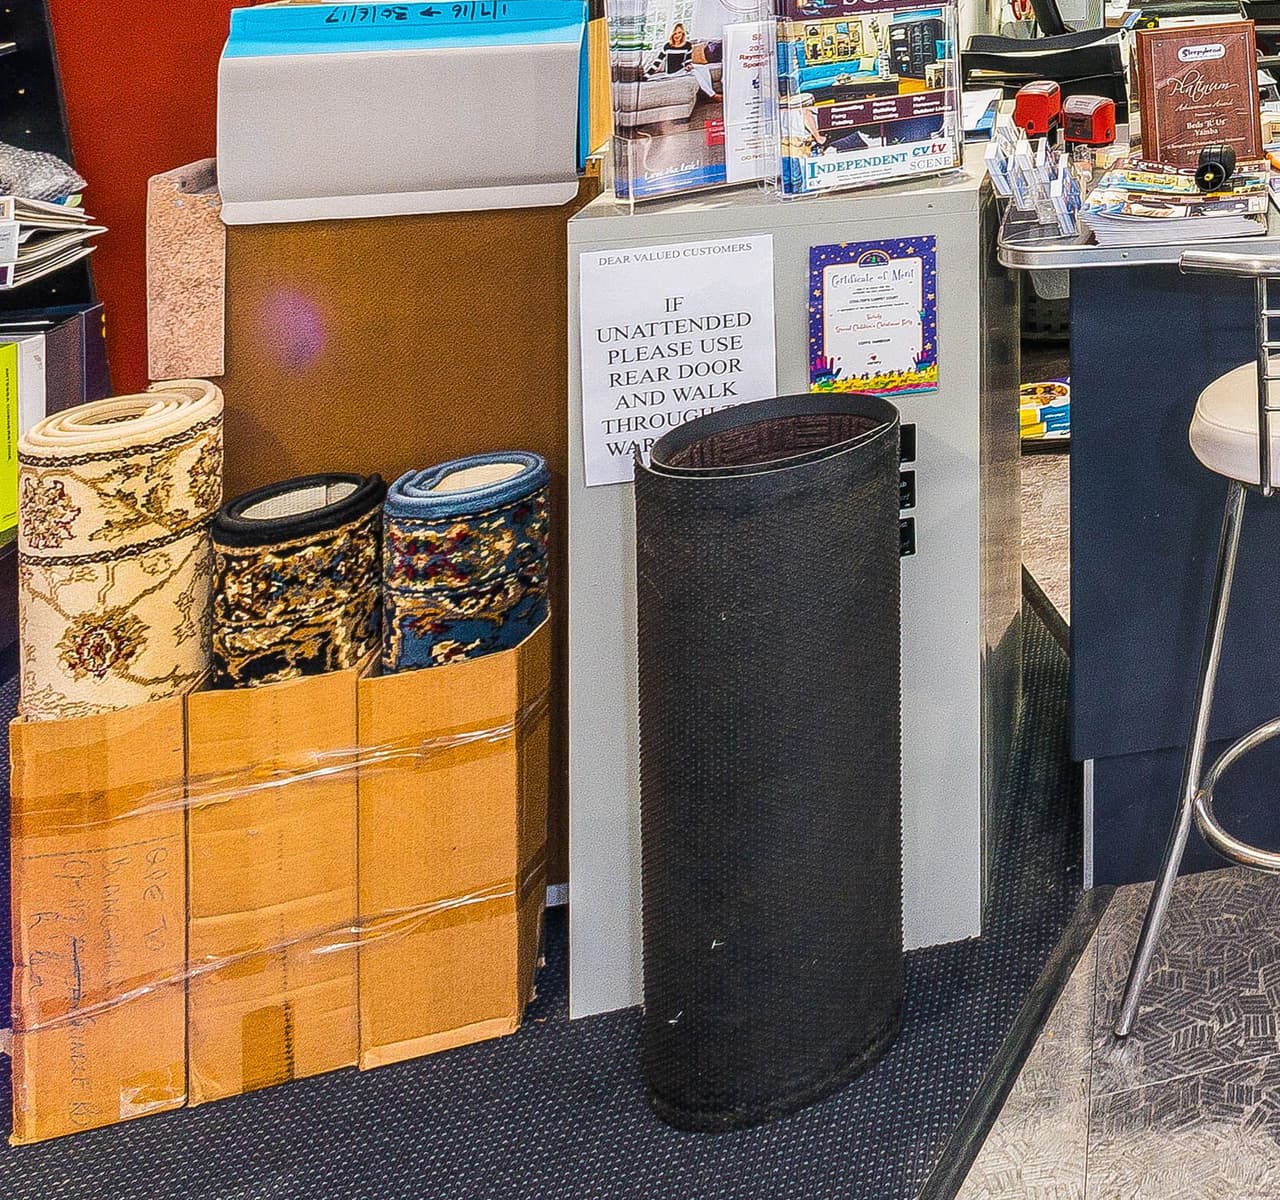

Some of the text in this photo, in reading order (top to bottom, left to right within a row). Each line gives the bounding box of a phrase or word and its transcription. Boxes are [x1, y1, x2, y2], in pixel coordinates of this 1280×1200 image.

[1167, 70, 1239, 102] Platinum
[910, 156, 951, 171] SCENE
[912, 143, 947, 157] cvtv
[808, 152, 908, 179] INDEPENDENT
[599, 243, 752, 266] DEAR VALUED CUSTOMERS
[832, 273, 874, 288] Certificate
[892, 269, 914, 282] Merit
[664, 297, 684, 313] IF
[596, 312, 752, 343] UNATTENDED
[608, 335, 744, 365] PLEASE USE
[609, 358, 743, 388] REAR DOOR
[615, 381, 739, 410] AND WALK
